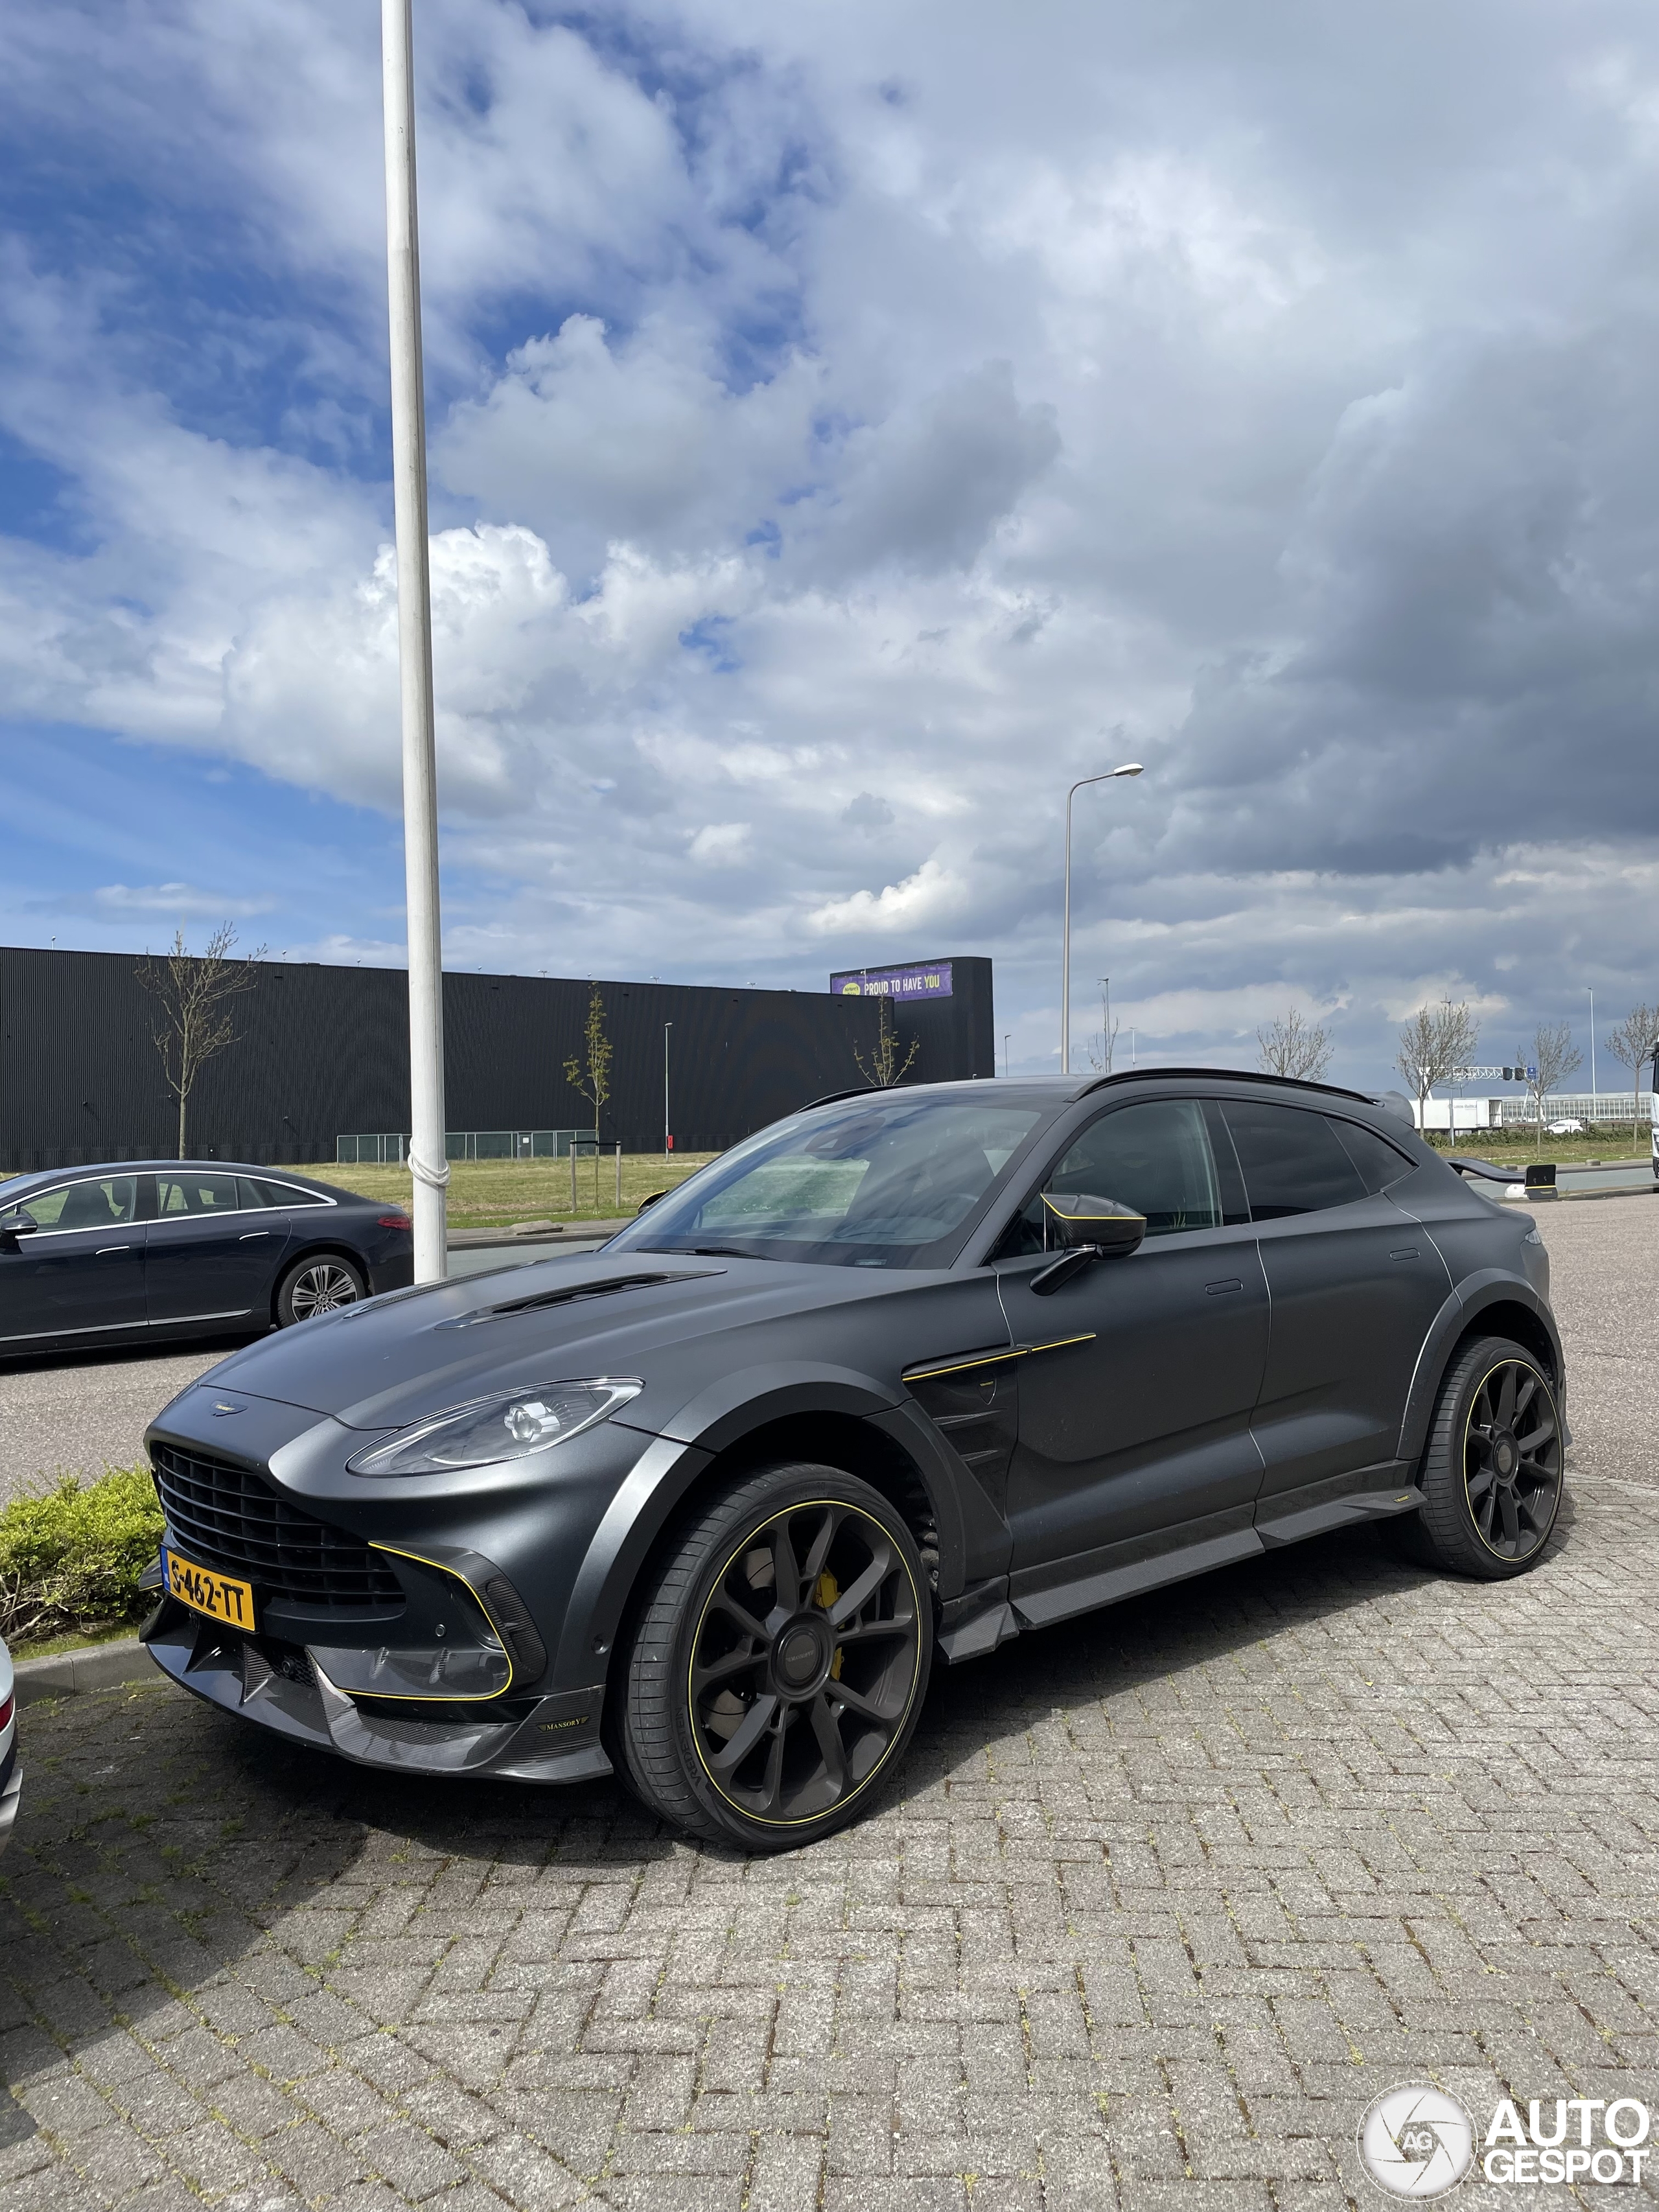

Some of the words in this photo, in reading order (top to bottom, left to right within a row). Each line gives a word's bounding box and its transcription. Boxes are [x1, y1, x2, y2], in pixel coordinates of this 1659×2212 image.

[864, 981, 888, 995] PROUD
[890, 979, 901, 993] TO
[903, 977, 922, 992] HAVE
[924, 974, 940, 989] YOU
[171, 1559, 244, 1622] S-462-TT
[546, 1718, 581, 1731] MANSORY
[675, 1706, 702, 1788] VREDESTEIN
